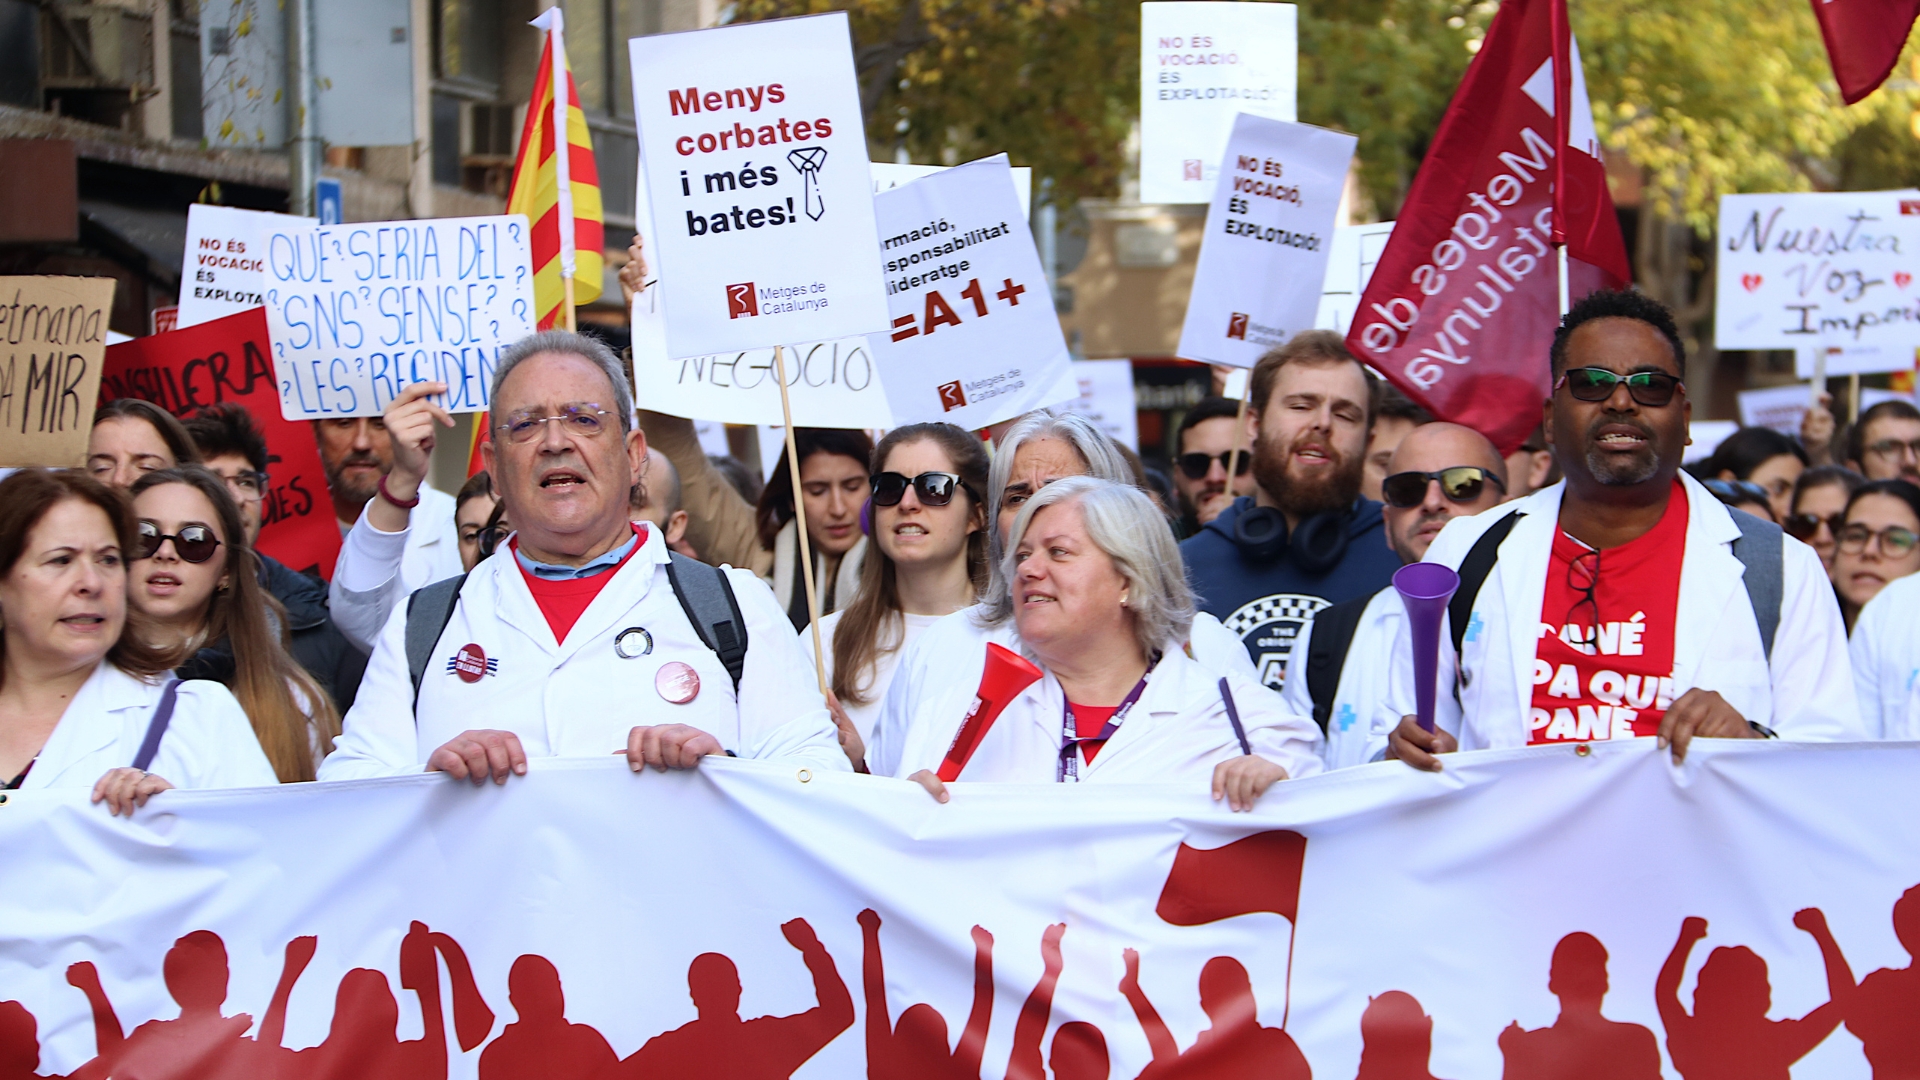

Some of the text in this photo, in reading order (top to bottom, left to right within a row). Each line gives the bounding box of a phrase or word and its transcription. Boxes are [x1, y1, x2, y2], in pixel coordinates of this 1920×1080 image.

[1158, 34, 1213, 49] NO ÉS
[1158, 69, 1181, 84] ÉS
[668, 83, 785, 116] Menys
[675, 117, 833, 156] corbates
[680, 161, 778, 196] i més
[1237, 155, 1284, 178] NO ÉS
[1228, 195, 1249, 215] ÉS
[1233, 176, 1302, 207] VOCACIÓ,
[686, 197, 796, 236] bates!
[1728, 206, 1902, 253] Nuestra
[199, 238, 246, 253] NO ÉS
[881, 218, 957, 251] rmació,
[883, 221, 1011, 274] sponsabilitat
[1224, 219, 1322, 252] EXPLOTACIÓ!
[348, 226, 441, 281] SERIA
[459, 223, 505, 280] DEL
[195, 268, 215, 283] ÉS
[760, 281, 827, 302] Metges de
[1784, 260, 1885, 303] Voz
[284, 291, 364, 350] SNS
[762, 295, 829, 315] Catalunya
[1783, 298, 1920, 341] Impor
[678, 342, 871, 391] NEGOCIO
[965, 367, 1022, 393] Metges de
[22, 351, 87, 434] MIR
[292, 358, 357, 413] LES
[968, 379, 1026, 404] Catalunya
